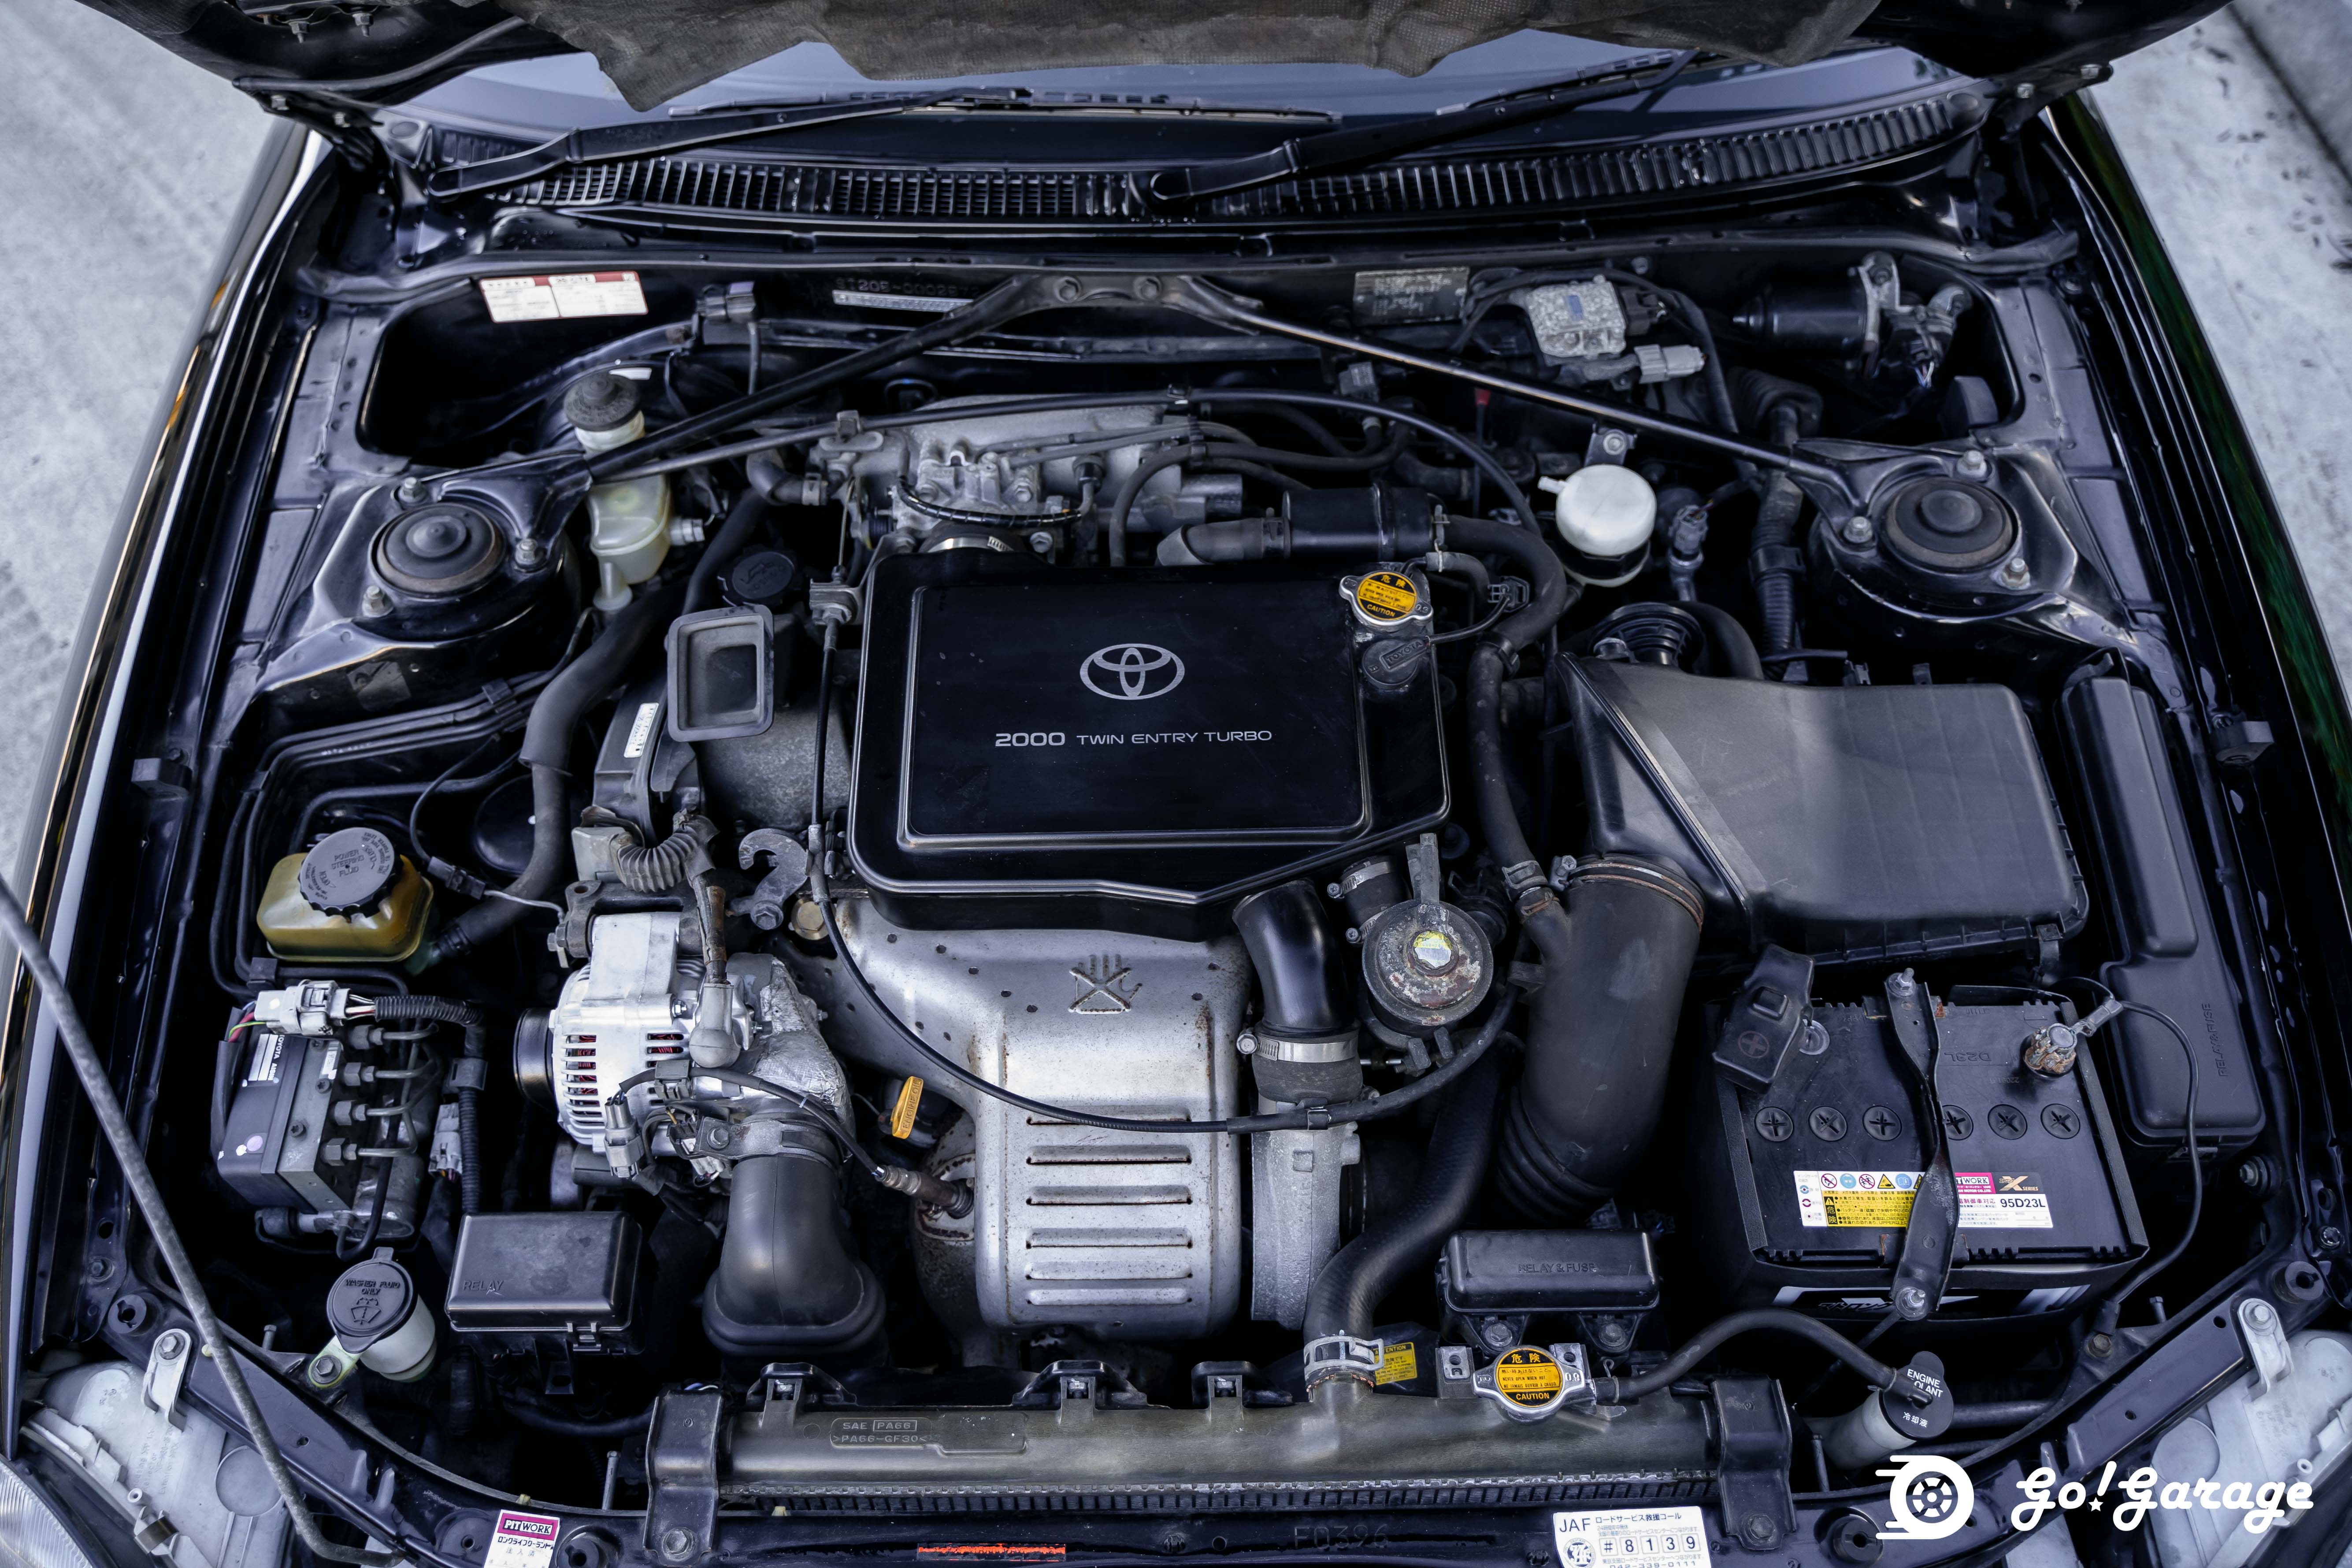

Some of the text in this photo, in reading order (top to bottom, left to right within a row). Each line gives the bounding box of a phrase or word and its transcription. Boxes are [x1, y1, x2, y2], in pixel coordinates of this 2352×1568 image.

[1367, 604, 1395, 617] CAUTION
[1386, 641, 1425, 663] TOYOTA
[995, 730, 1272, 746] 2000 TWIN ENTRY TURBO
[334, 849, 359, 861] POWER
[339, 866, 359, 877] FLUID
[1944, 1052, 1992, 1062] D23L
[902, 1081, 921, 1128] ENGINE OIL
[2000, 1198, 2046, 1208] 95D23L
[1518, 1263, 1554, 1272] RELAY
[1566, 1263, 1596, 1272] FUSE
[463, 1280, 504, 1291] RELAY
[1907, 1368, 1941, 1388] ENGINE
[1903, 1411, 1928, 1428] 冷却液
[1559, 1512, 1682, 1532] JAF ロードサービス救援コール
[498, 1536, 554, 1550] ロングライフクーラント
